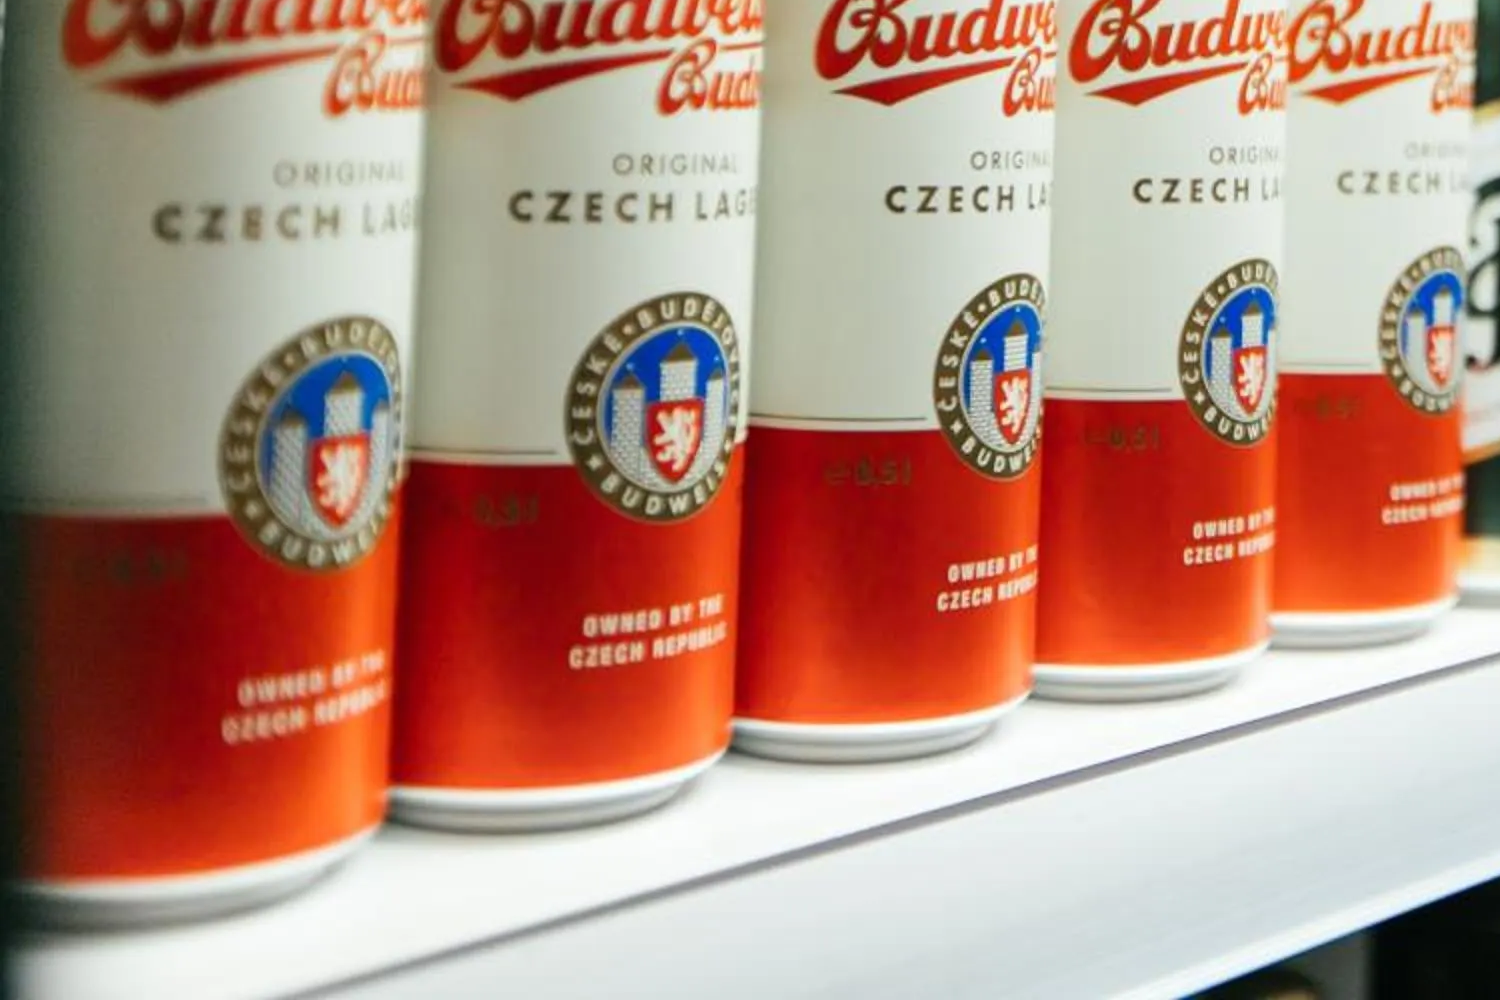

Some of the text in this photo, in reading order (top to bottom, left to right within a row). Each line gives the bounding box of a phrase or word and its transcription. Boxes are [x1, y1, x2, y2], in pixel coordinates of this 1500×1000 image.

[1132, 177, 1250, 204] CZECH
[1337, 169, 1441, 195] CZECH
[508, 190, 674, 224] CZECH
[884, 184, 1015, 214] CZECH
[152, 204, 342, 244] CZECH
[1193, 517, 1245, 539] OWNED
[1183, 543, 1233, 566] CZECH
[948, 557, 1005, 583] OWNED
[937, 586, 993, 612] CZECH
[583, 608, 662, 638] OWNED
[669, 602, 694, 627] BY
[568, 641, 645, 670] CZECH
